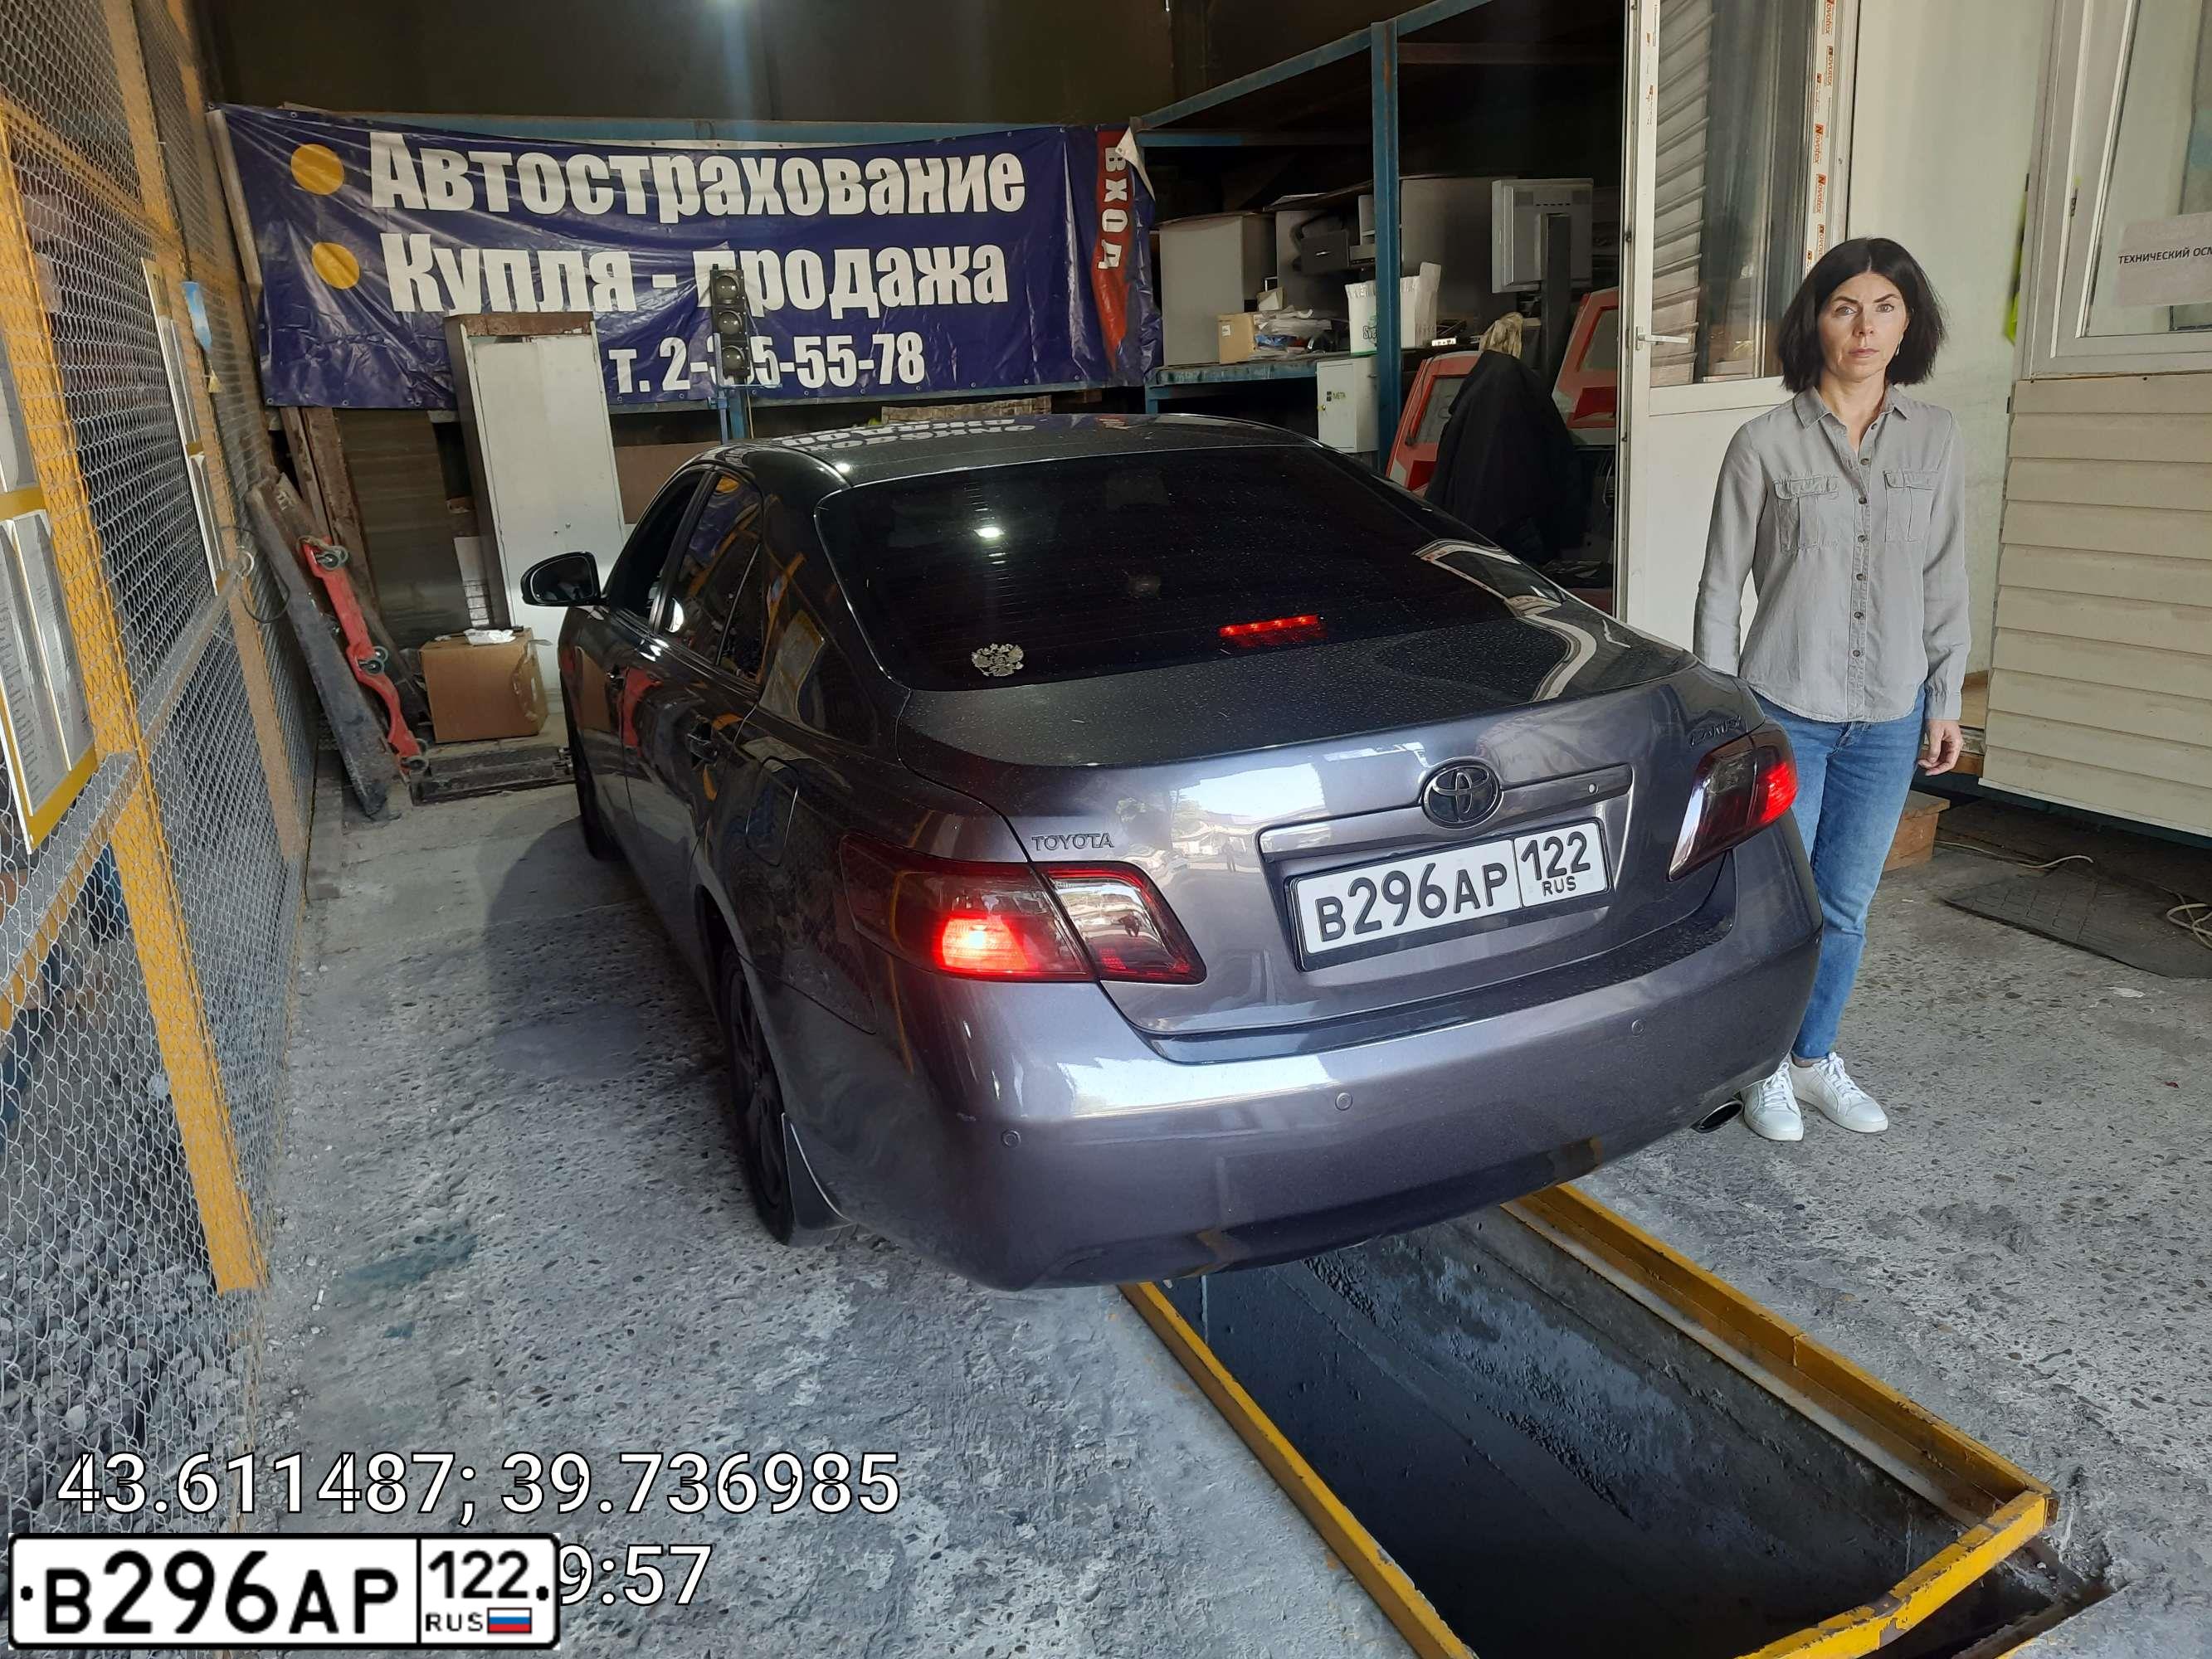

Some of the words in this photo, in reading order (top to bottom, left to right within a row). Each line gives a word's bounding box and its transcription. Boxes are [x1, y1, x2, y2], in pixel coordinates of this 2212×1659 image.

[1815, 123, 1824, 164] Novotex
[370, 132, 1026, 223] Автострахование
[1816, 173, 1826, 213] Novotex
[1098, 147, 1128, 270] ВХОД
[380, 232, 637, 317] Купля
[693, 244, 1008, 319] продажа
[2118, 247, 2190, 265] ТЕХНИЧЕСКИЙ
[608, 348, 650, 394] т.
[1031, 832, 1114, 851] TOYOTA
[1315, 862, 1508, 942] В296АР
[1519, 831, 1591, 882] 122
[1542, 875, 1576, 896] RUS
